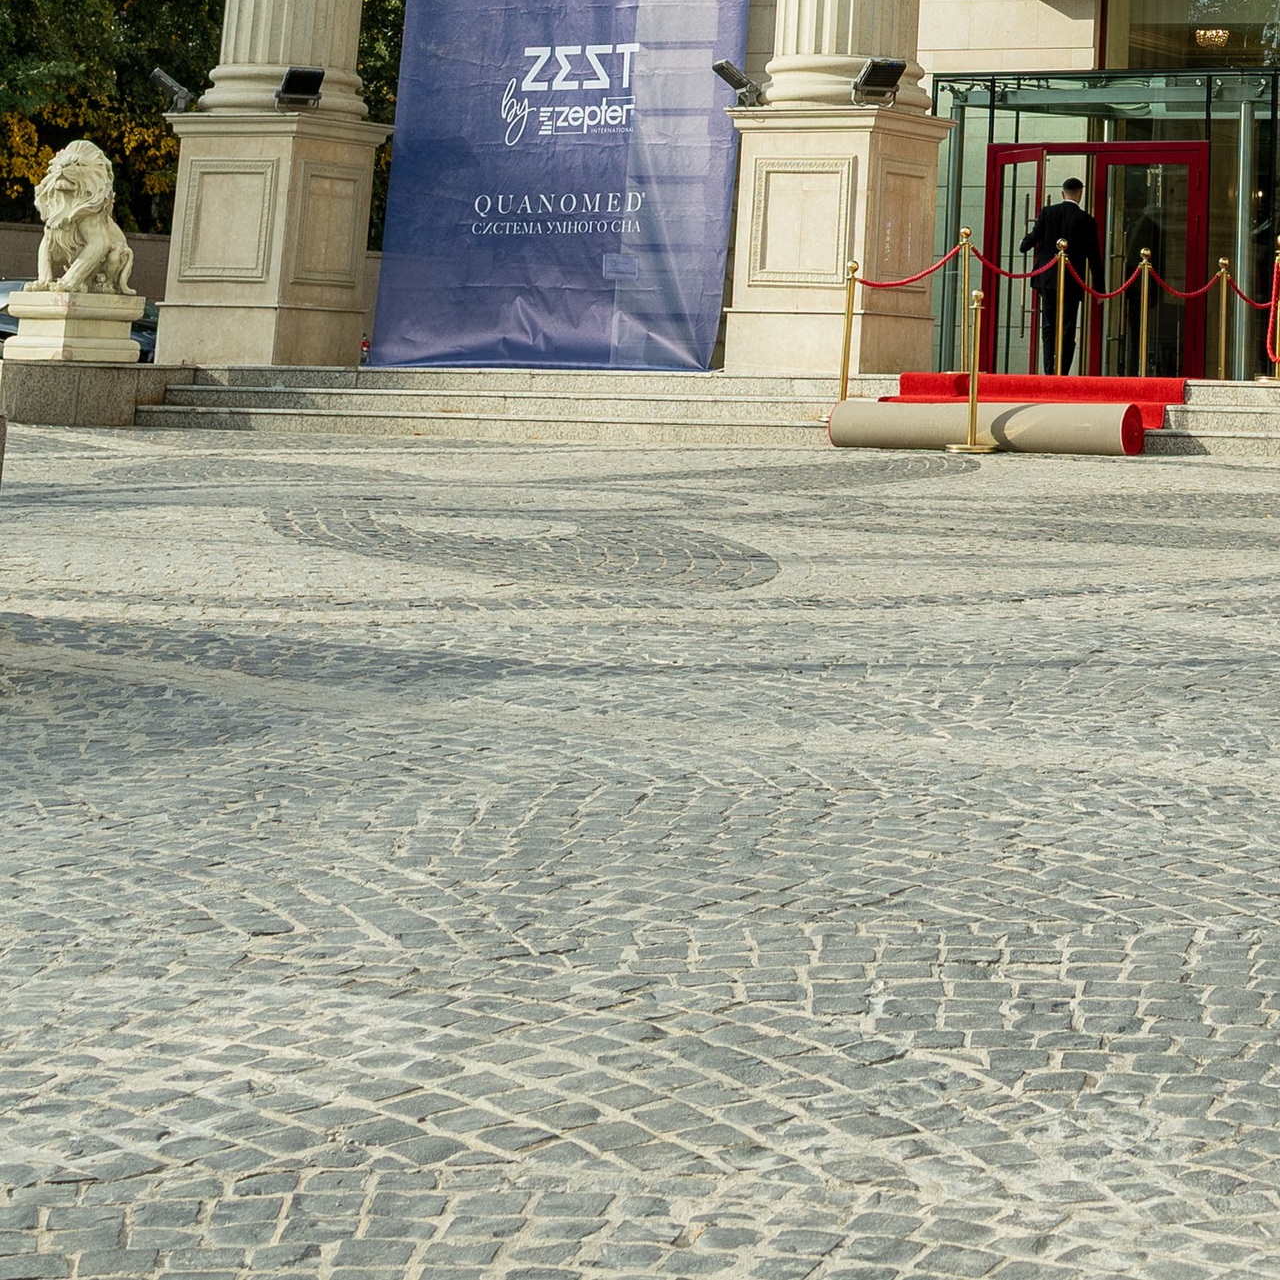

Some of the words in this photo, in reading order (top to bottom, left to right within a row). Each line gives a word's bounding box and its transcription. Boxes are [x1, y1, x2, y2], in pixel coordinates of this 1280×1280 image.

[501, 78, 536, 146] by
[553, 97, 635, 134] zepter
[590, 126, 634, 134] INTERNATIONAL
[474, 192, 642, 217] QUANOMED
[471, 221, 543, 235] СИСТЕМА
[546, 220, 608, 234] УМНОГО
[611, 219, 642, 233] СНА
